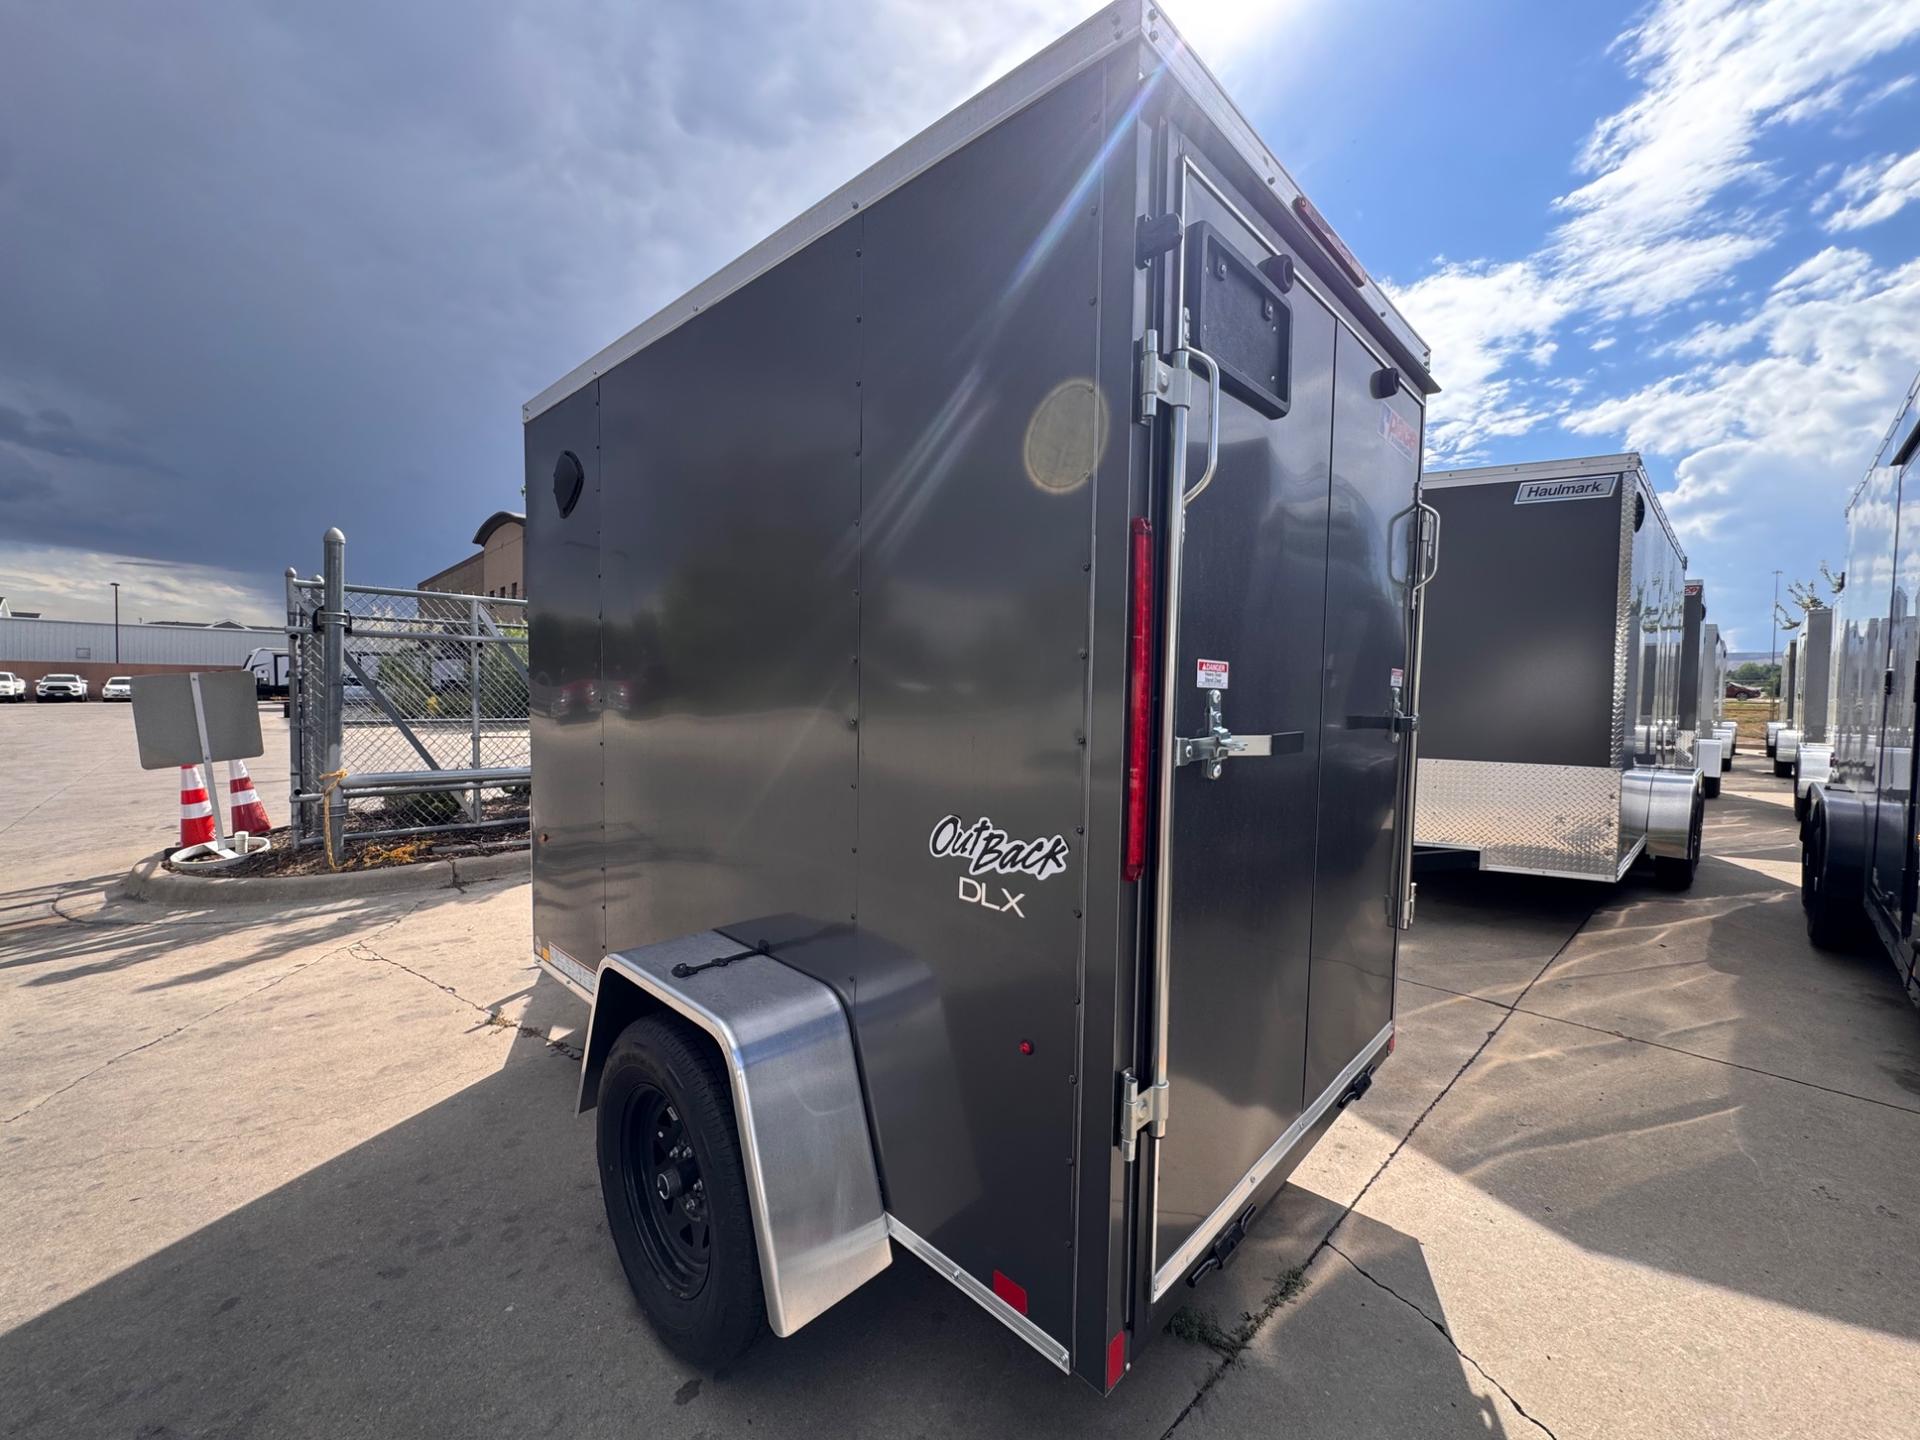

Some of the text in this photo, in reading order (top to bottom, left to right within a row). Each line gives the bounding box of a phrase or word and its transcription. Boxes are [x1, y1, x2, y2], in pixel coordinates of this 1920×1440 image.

[1526, 481, 1602, 498] Haulmark
[1206, 663, 1225, 672] DANGER
[958, 876, 1026, 919] DLX
